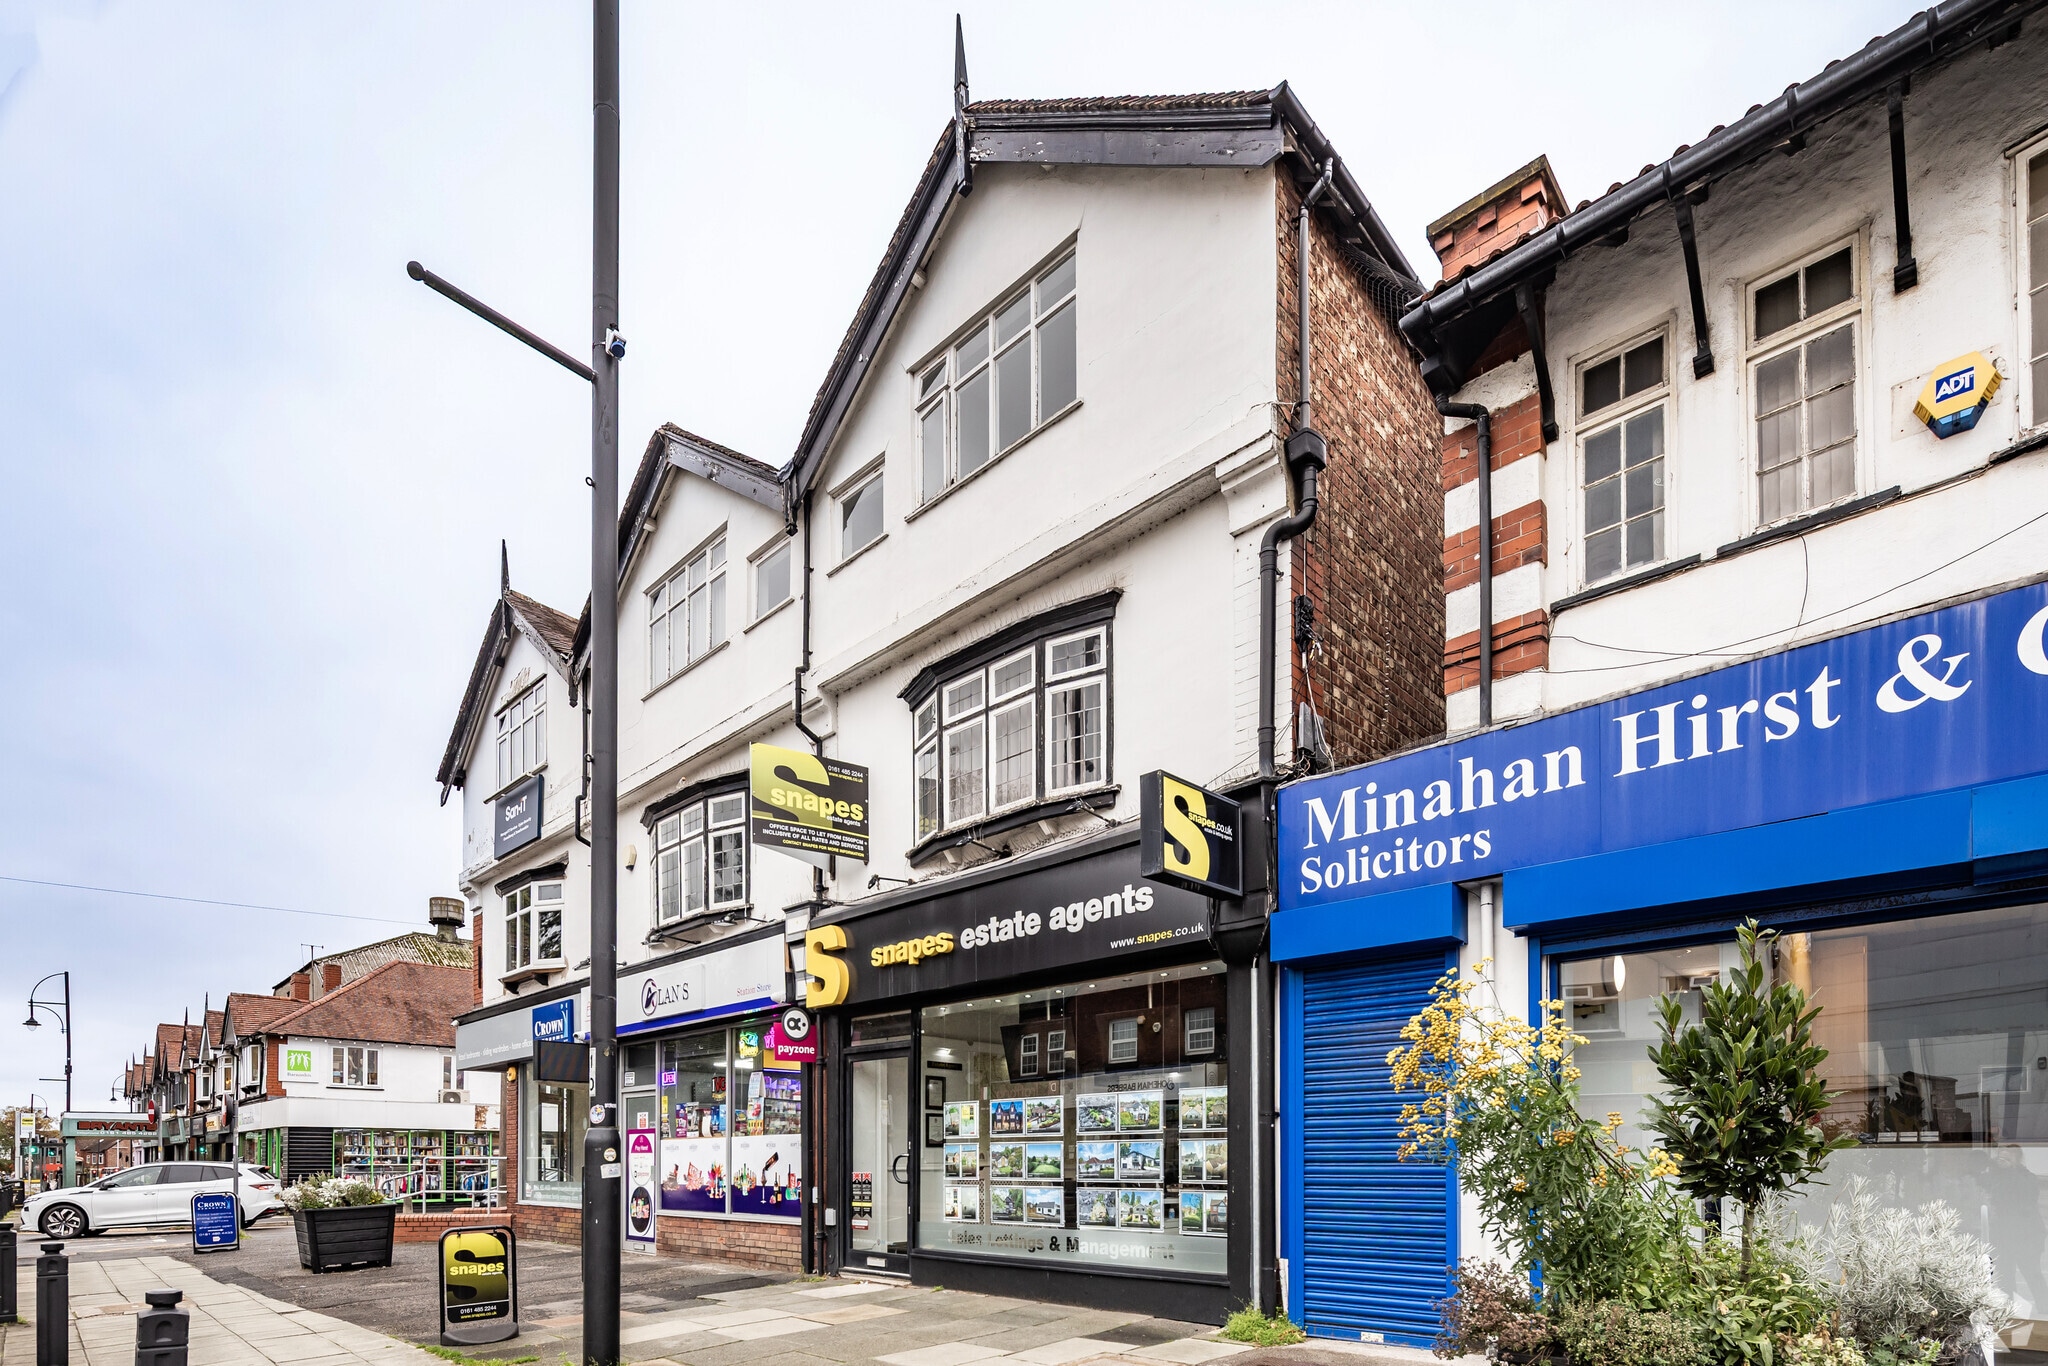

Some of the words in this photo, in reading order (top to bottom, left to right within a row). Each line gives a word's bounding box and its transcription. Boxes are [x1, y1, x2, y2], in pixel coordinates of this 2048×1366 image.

[1936, 369, 1974, 400] ADT
[1302, 745, 1586, 850] Minahan
[1612, 665, 1842, 778] Hirst
[1875, 633, 1973, 714] &
[770, 787, 864, 821] snapes
[768, 823, 789, 831] OFFICE
[789, 826, 807, 835] SPACE
[827, 832, 842, 840] FROM
[826, 815, 843, 823] estate
[843, 818, 861, 827] agents
[762, 829, 791, 838] INCLUSIVE
[840, 841, 864, 851] SERVICES
[1300, 828, 1492, 895] Solicitors
[871, 931, 955, 968] snapes
[960, 909, 1042, 949] estate
[1048, 883, 1154, 933] agents
[1110, 922, 1204, 949] www.snapes.co.uk
[756, 983, 771, 992] Store
[777, 1044, 815, 1056] payzone
[1049, 1235, 1061, 1252] &
[449, 1262, 505, 1276] snapes
